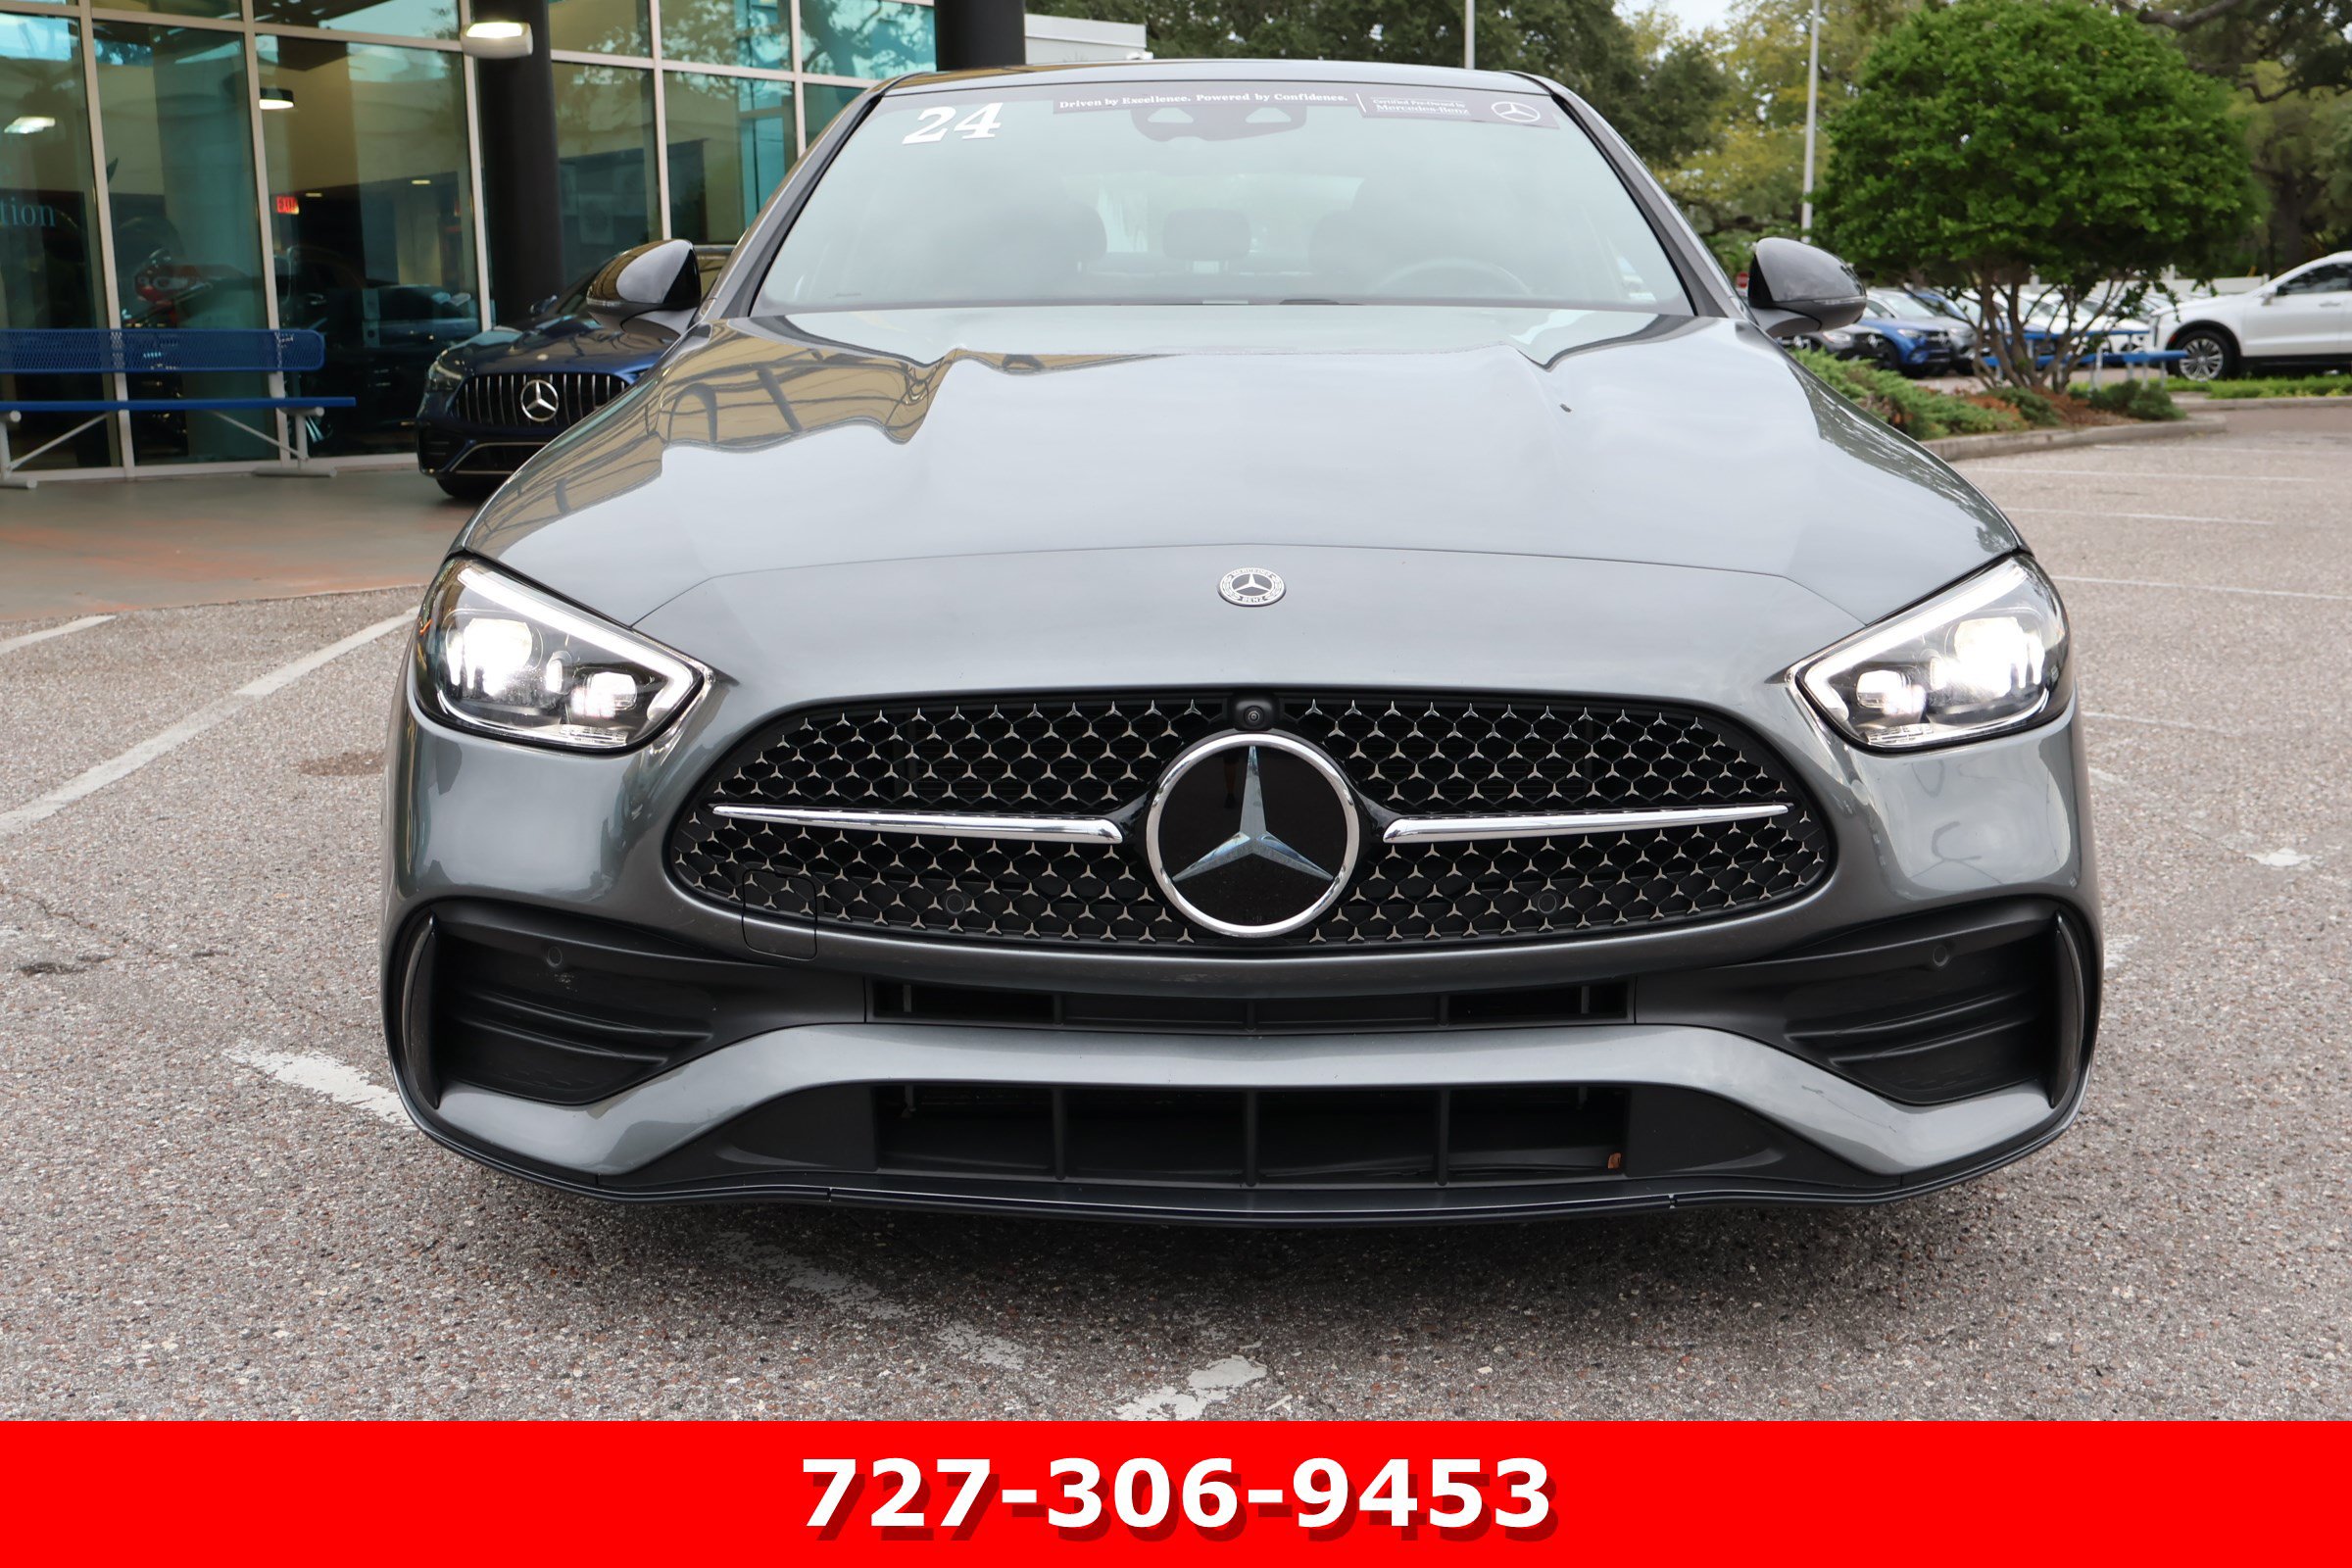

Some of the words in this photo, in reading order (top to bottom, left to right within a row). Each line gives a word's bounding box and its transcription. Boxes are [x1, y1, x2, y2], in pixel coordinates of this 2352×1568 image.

[1059, 99, 1102, 109] Driven
[1104, 98, 1118, 107] by
[1122, 95, 1192, 105] Excellence.
[1196, 93, 1250, 102] Powered
[1254, 92, 1270, 102] by
[1274, 92, 1348, 102] Confidence.
[1376, 104, 1470, 116] Mercedes-Benz
[902, 102, 1004, 145] 24
